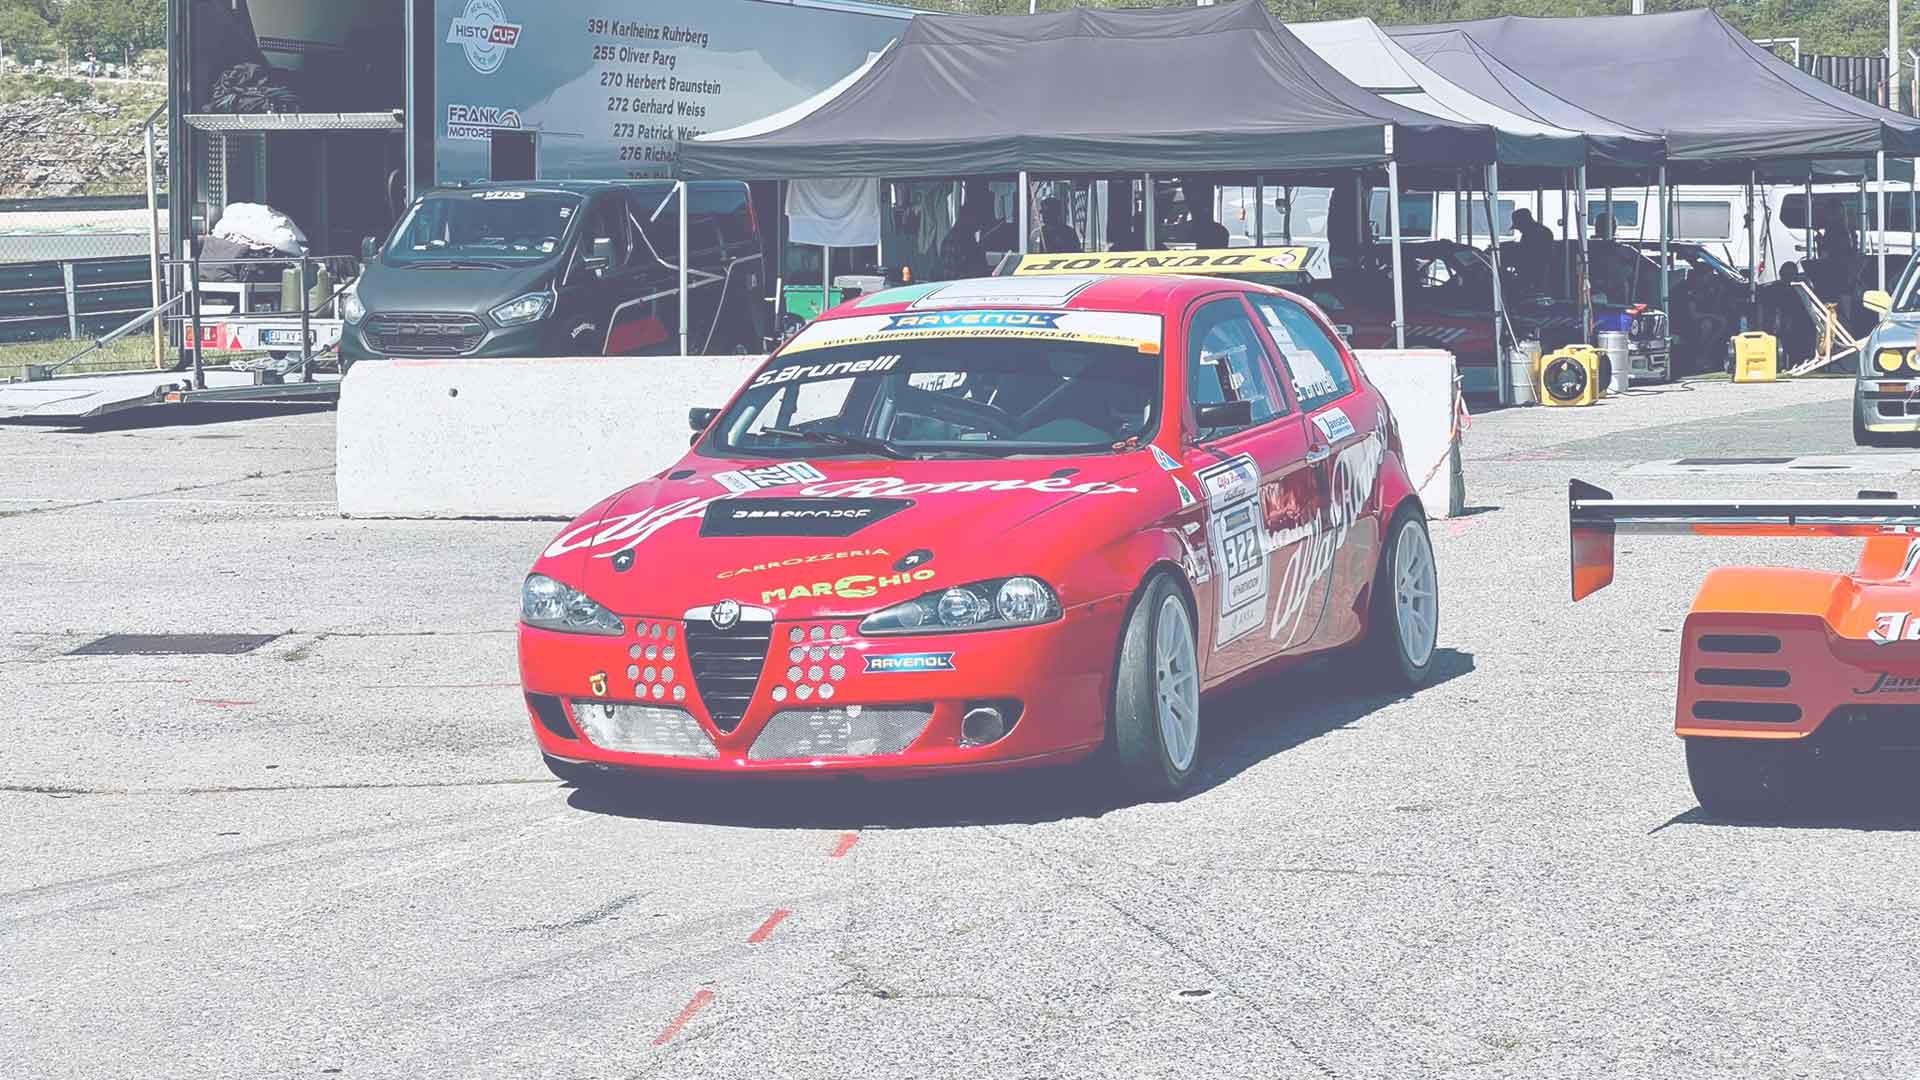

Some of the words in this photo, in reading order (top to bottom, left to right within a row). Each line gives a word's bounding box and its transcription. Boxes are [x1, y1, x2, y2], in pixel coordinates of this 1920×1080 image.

[456, 24, 489, 39] HISTO
[492, 27, 516, 42] CUP
[588, 19, 608, 33] 391
[611, 20, 660, 40] Karlheinz
[662, 26, 709, 48] Ruhrberg
[593, 46, 615, 60] 255
[619, 47, 650, 64] Oliver
[653, 50, 677, 70] Parg
[601, 71, 622, 87] 270
[626, 73, 666, 90] Herbert
[669, 77, 721, 95] Braunstein
[449, 107, 499, 124] FRANK
[607, 96, 629, 112] 272
[632, 98, 674, 115] Gerhard
[677, 101, 706, 117] Weiss
[613, 123, 634, 138] 273
[638, 124, 674, 140] Patrick
[677, 126, 707, 141] Wei
[619, 146, 641, 161] 276
[1022, 253, 1254, 272] DUNLOP
[895, 311, 1050, 328] RAVENOL
[1225, 528, 1260, 578] 322
[716, 548, 889, 579] CARROZZERIA
[760, 569, 936, 605] MARCHIO
[870, 657, 948, 669] RAVENOL
